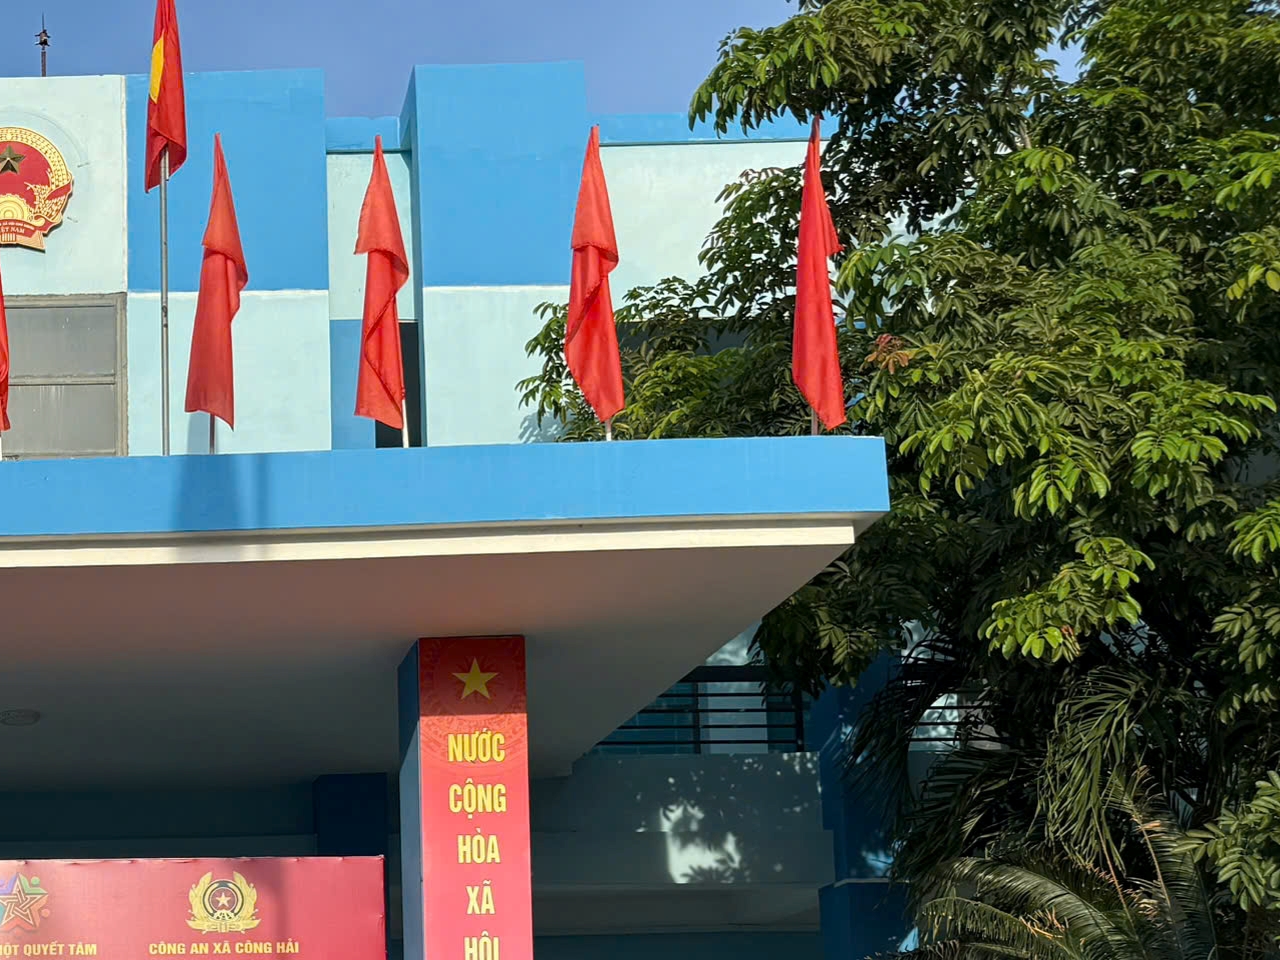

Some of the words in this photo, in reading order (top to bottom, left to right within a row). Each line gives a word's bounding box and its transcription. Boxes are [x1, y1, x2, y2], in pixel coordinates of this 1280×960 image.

[447, 731, 506, 763] NƯỚC
[448, 781, 507, 820] CỘNG
[457, 828, 501, 864] HÒA
[466, 880, 496, 915] XÃ
[23, 941, 65, 958] QUYẾT
[68, 941, 97, 957] TÂM
[148, 940, 186, 955] CÔNG
[189, 942, 209, 955] AN
[212, 940, 231, 955] XÃ
[235, 940, 273, 955] CÔNG
[276, 938, 300, 954] HẢI
